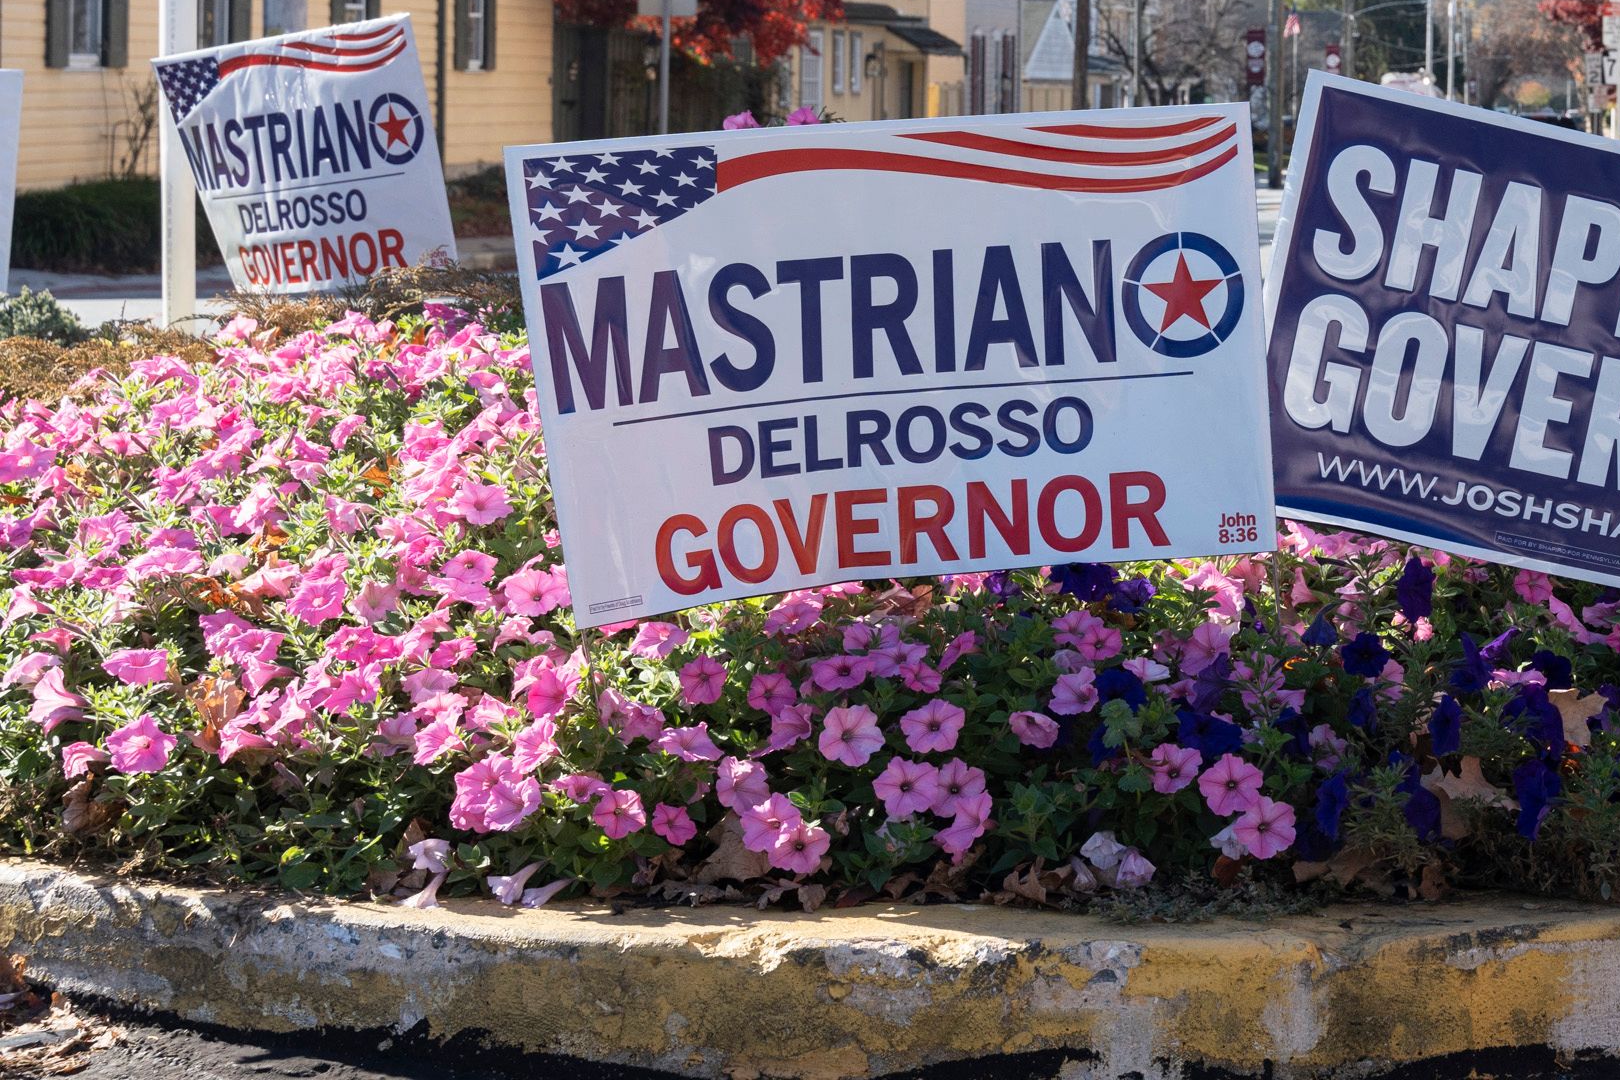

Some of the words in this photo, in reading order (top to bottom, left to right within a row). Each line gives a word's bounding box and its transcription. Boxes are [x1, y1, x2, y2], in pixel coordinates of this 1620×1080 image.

[178, 92, 424, 192] MASTRIANO
[238, 188, 367, 235] DELROSSO
[238, 228, 408, 286] GOVERNOR
[538, 231, 1245, 414] MASTRIANO
[707, 396, 1094, 486] DELROSSO
[654, 471, 1171, 596] GOVERNOR
[1218, 512, 1256, 528] John
[1218, 526, 1258, 544] 8:36
[1497, 535, 1513, 544] PAID
[1514, 538, 1527, 547] FOR
[1528, 541, 1538, 549] BY
[1538, 542, 1568, 555] SHAPIRO
[1567, 548, 1582, 558] FOR
